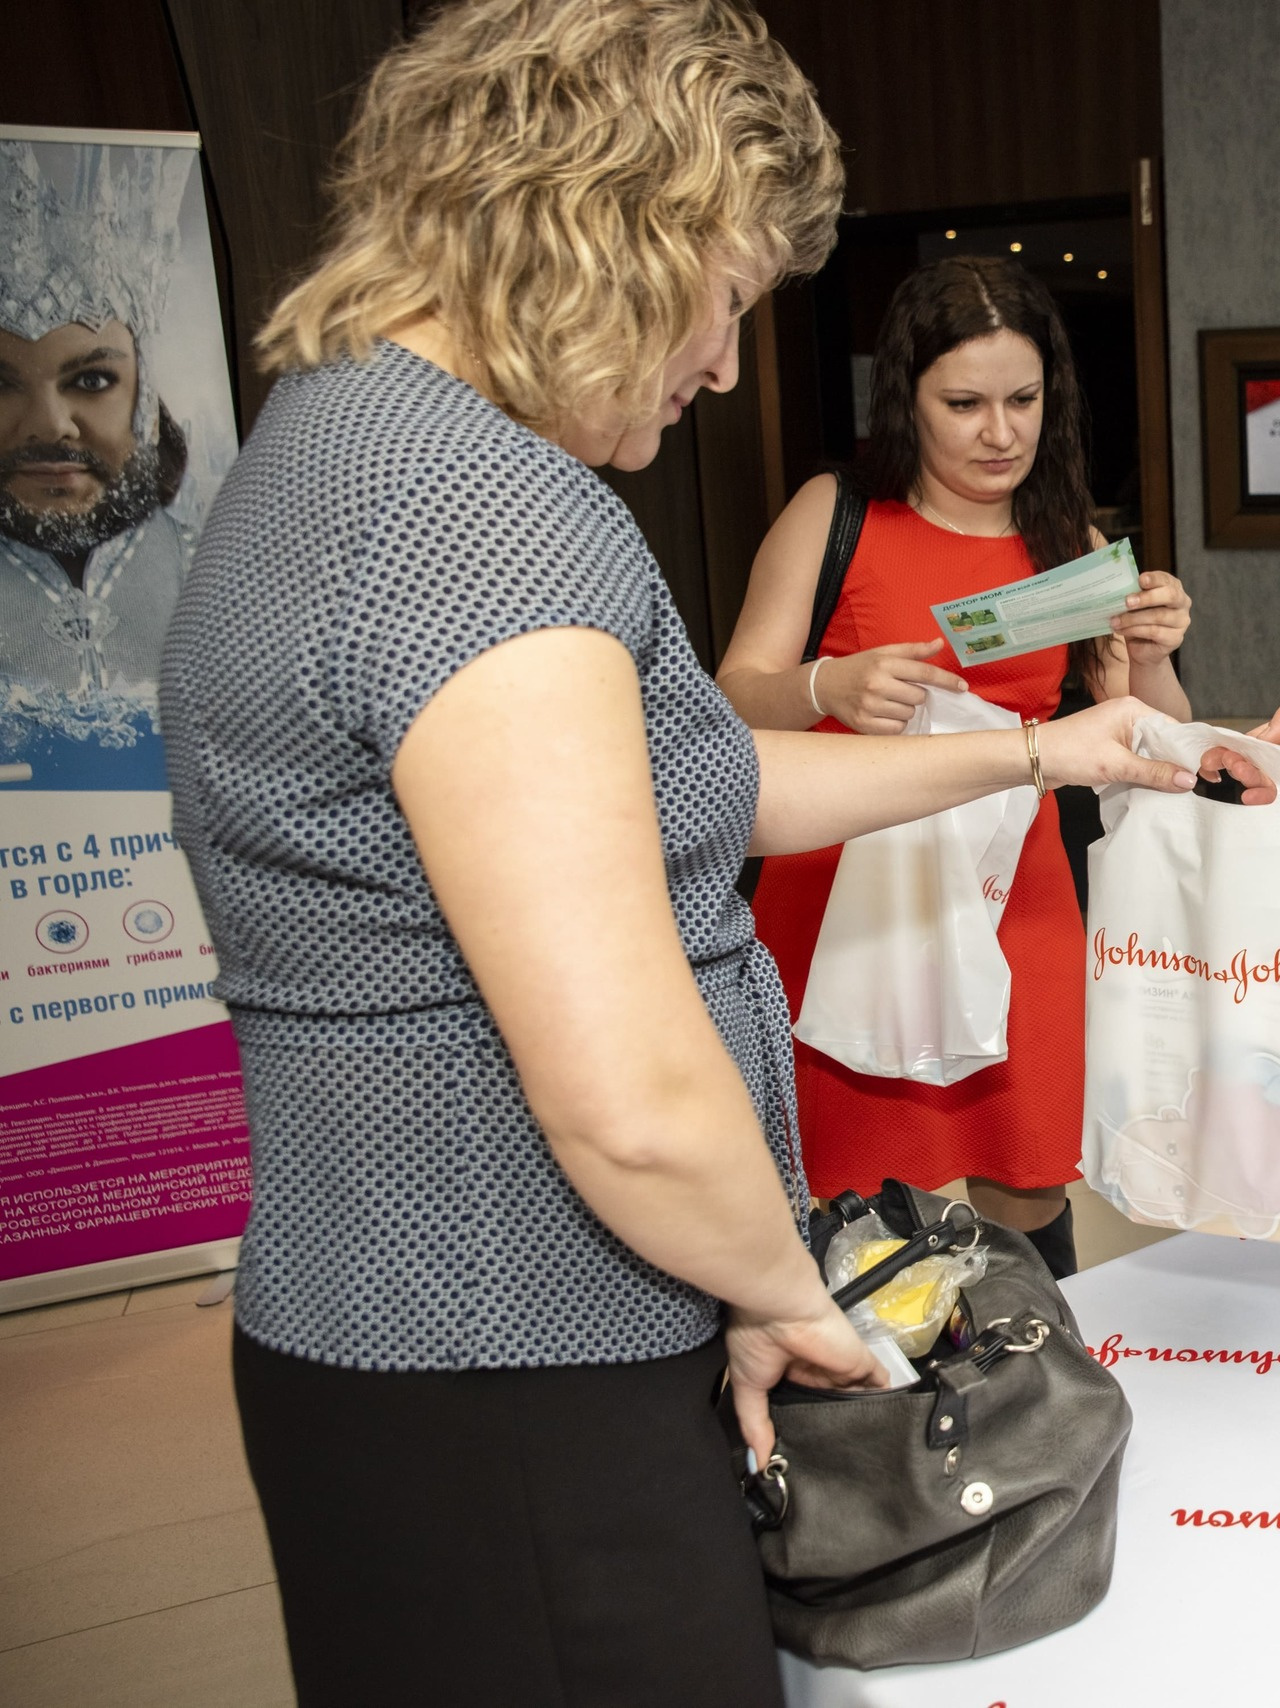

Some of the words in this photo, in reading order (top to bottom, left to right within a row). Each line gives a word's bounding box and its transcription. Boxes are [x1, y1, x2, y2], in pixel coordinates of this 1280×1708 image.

[942, 598, 979, 612] ДОКТОР
[56, 841, 73, 863] с
[83, 834, 100, 859] 4
[10, 878, 28, 900] в
[38, 867, 133, 898] горле:
[27, 957, 110, 977] бактериями
[126, 948, 183, 966] грибами
[10, 1006, 24, 1024] с
[32, 991, 135, 1022] первого
[4, 1206, 25, 1219] НА
[28, 1194, 99, 1215] КОТОРОМ
[102, 1173, 208, 1201] МЕДИЦИНСКИЙ
[13, 1177, 126, 1205] ИСПОЛЬЗУЕТСЯ
[128, 1173, 147, 1184] НА
[149, 1156, 249, 1182] МЕРОПРИЯТИИ
[74, 1197, 219, 1232] ФАРМАЦЕВТИЧЕСКИХ
